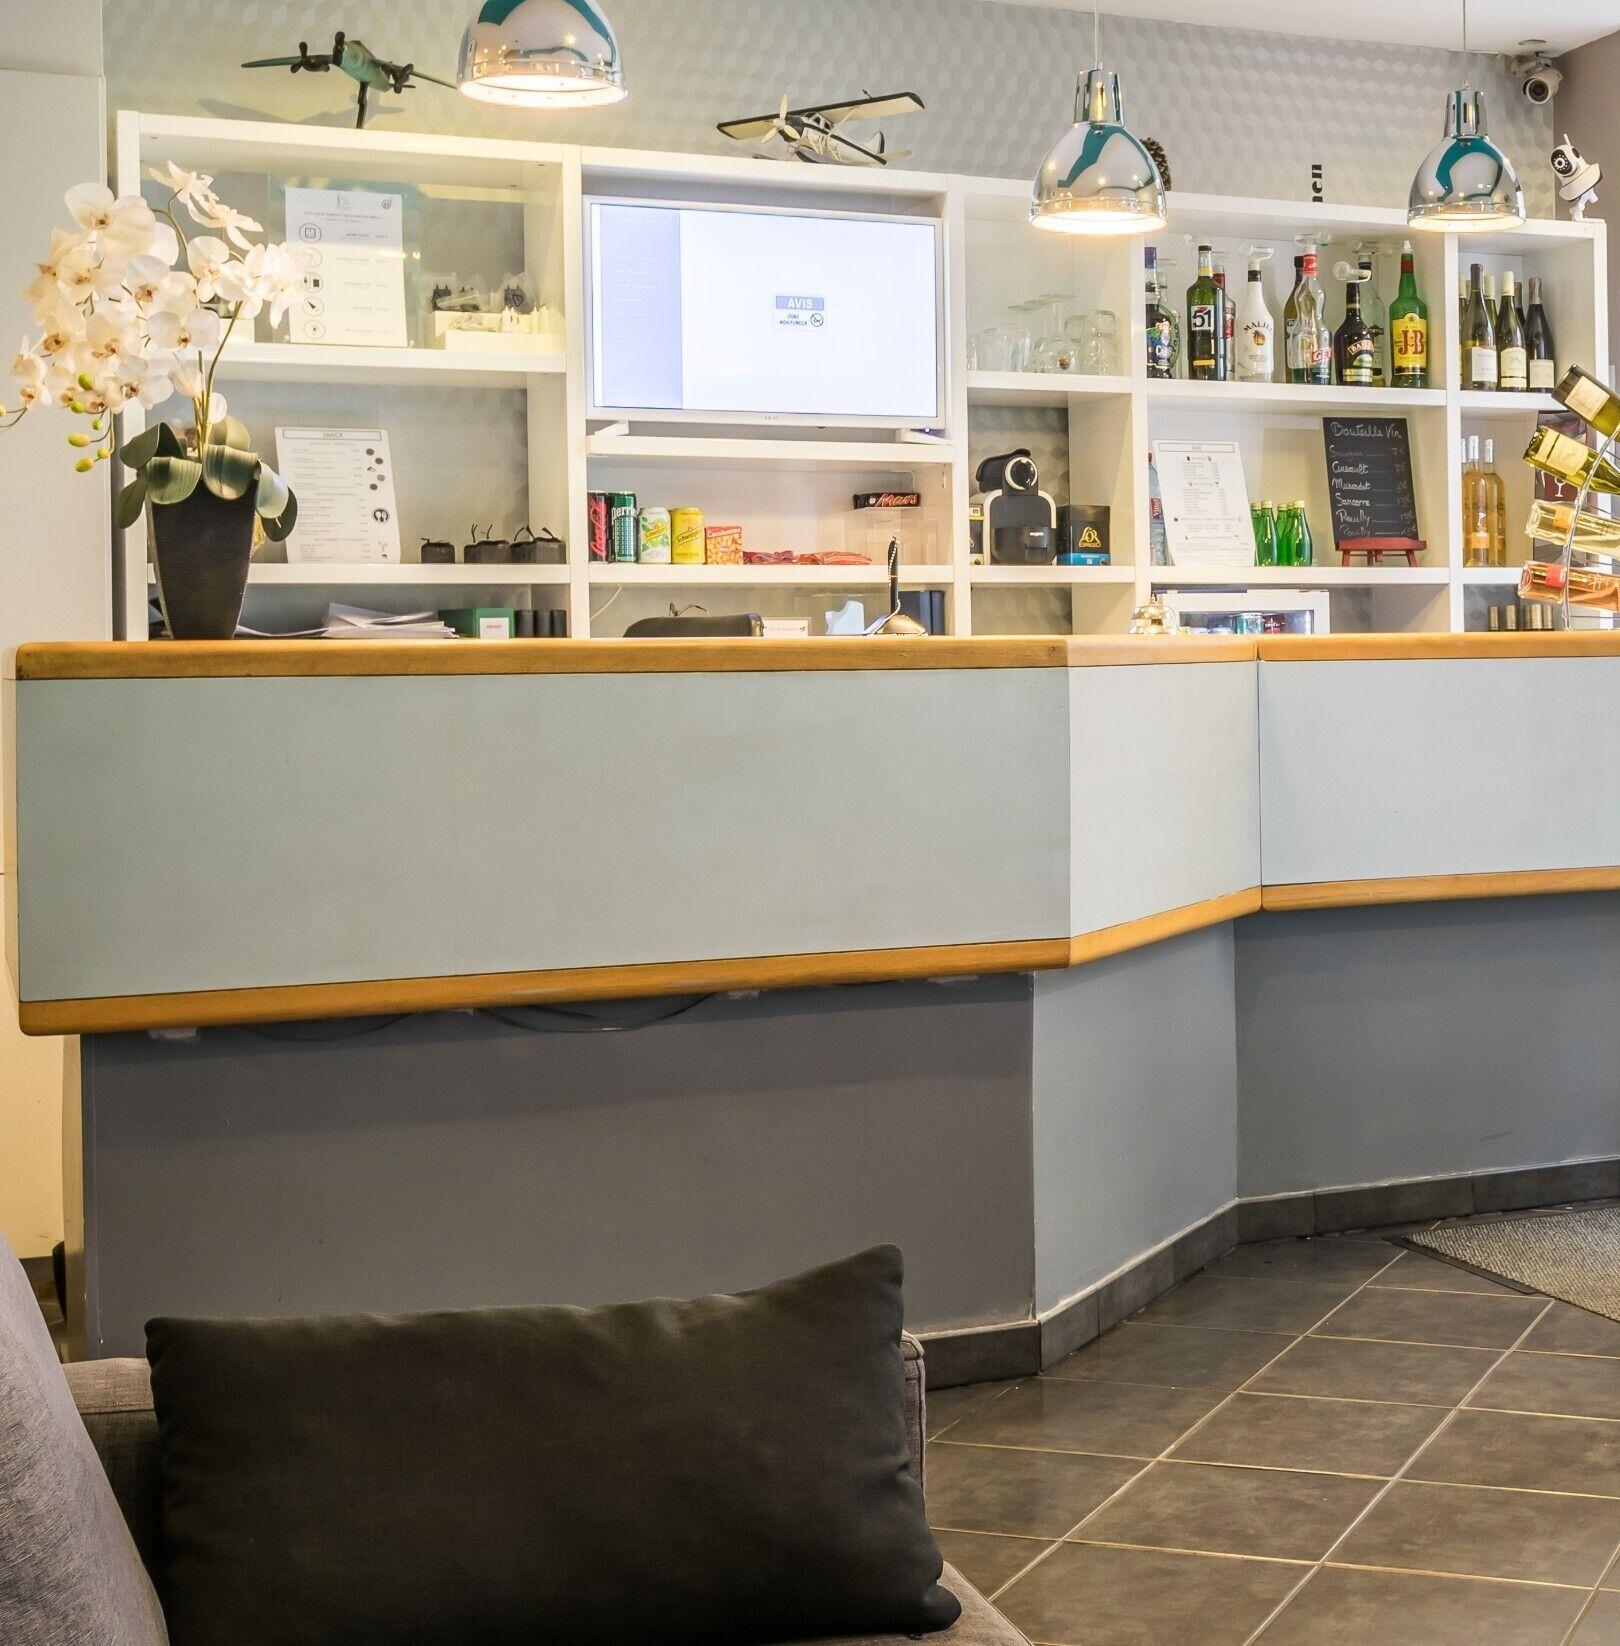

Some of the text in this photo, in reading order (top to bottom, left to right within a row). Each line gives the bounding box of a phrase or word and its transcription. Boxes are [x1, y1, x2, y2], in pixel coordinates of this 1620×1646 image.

[787, 297, 813, 309] AVIS
[1193, 310, 1211, 328] 51
[1386, 423, 1402, 438] Vin
[875, 493, 918, 507] Mars
